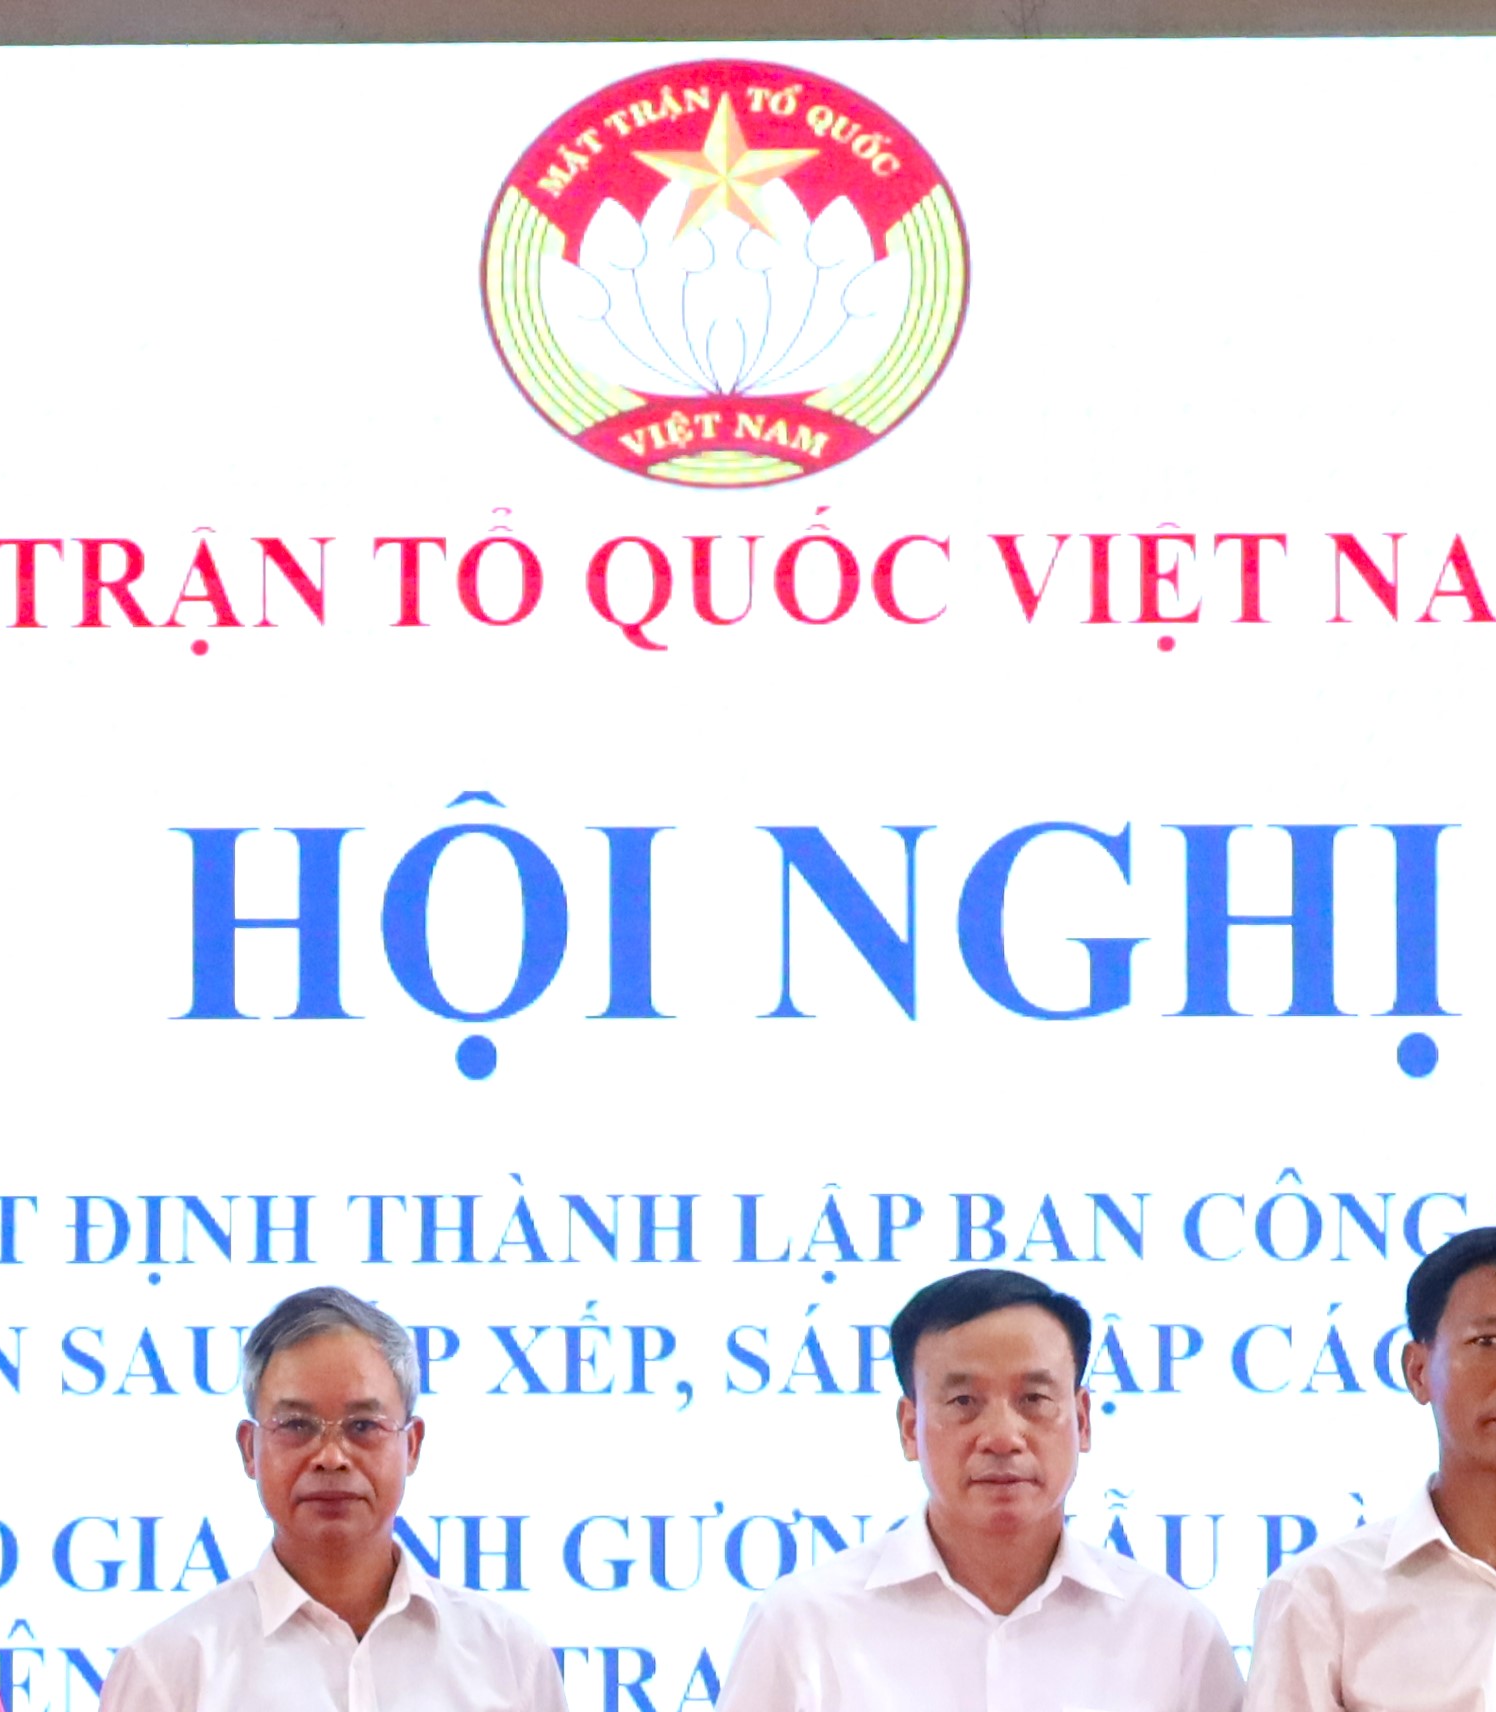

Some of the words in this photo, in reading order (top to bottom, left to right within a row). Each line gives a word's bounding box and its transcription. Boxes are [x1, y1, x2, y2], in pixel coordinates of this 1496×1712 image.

[537, 128, 605, 199] MẶT
[604, 85, 712, 138] TRẬN
[746, 83, 803, 116] TỔ
[806, 102, 902, 179] QUỐC
[618, 409, 720, 459] VIỆT
[734, 411, 831, 459] NAM
[368, 506, 549, 628] TỔ
[581, 504, 955, 652] QUỐC
[986, 522, 1292, 653] VIỆT
[168, 789, 677, 1081] HỘI
[755, 820, 1463, 1078] NGHỊ
[69, 1195, 313, 1285] ĐỊNH
[348, 1172, 698, 1264] THÀNH
[736, 1183, 923, 1284] LẬP
[952, 1194, 1144, 1262] BAN
[1185, 1167, 1468, 1260] CÔNG
[61, 1326, 246, 1396] SAU
[490, 1300, 692, 1410] XẾP,
[728, 1300, 893, 1393] SÁP
[1087, 1312, 1204, 1415] ẬP
[52, 1516, 231, 1592] GIA
[394, 1514, 528, 1591] NH
[1063, 1488, 1225, 1591] ẪU
